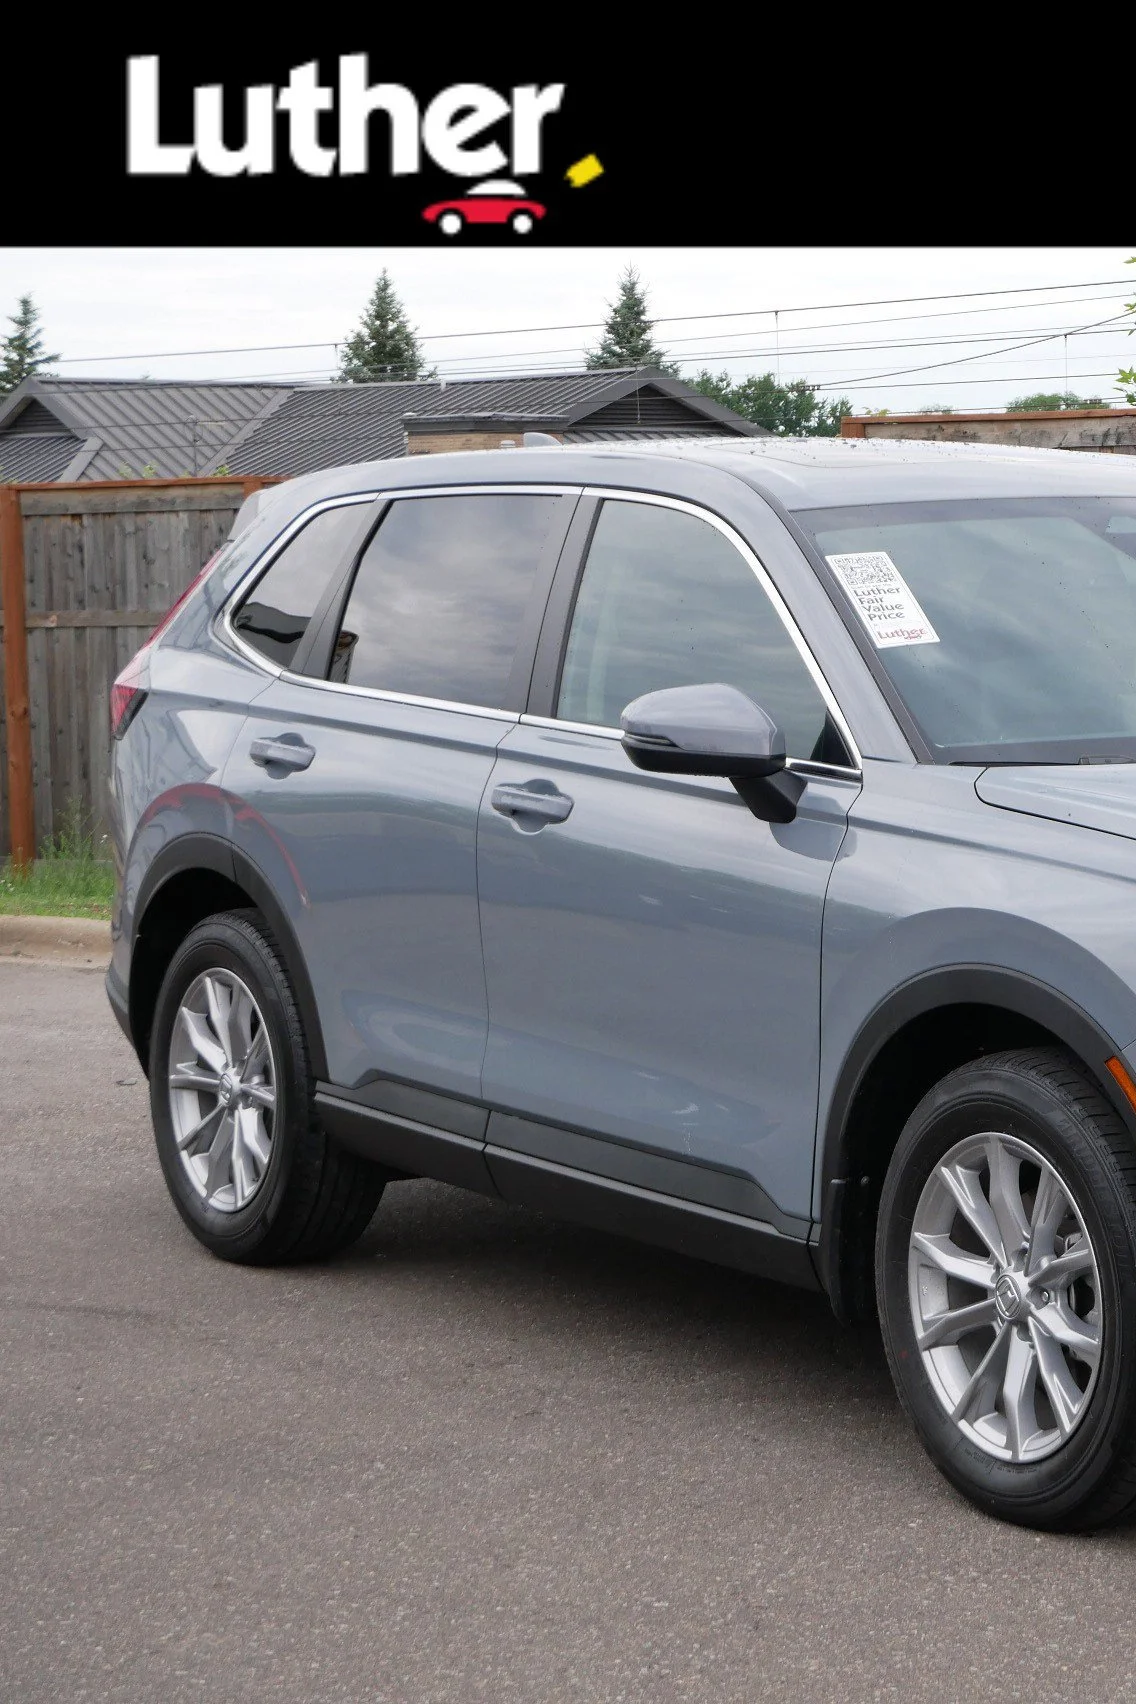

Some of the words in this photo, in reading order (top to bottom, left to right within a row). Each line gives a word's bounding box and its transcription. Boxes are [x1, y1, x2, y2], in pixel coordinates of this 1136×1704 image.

[853, 586, 901, 597] Luther
[858, 596, 885, 605] Fair
[862, 602, 905, 613] Value
[867, 611, 906, 622] Price
[876, 627, 926, 640] Luther
